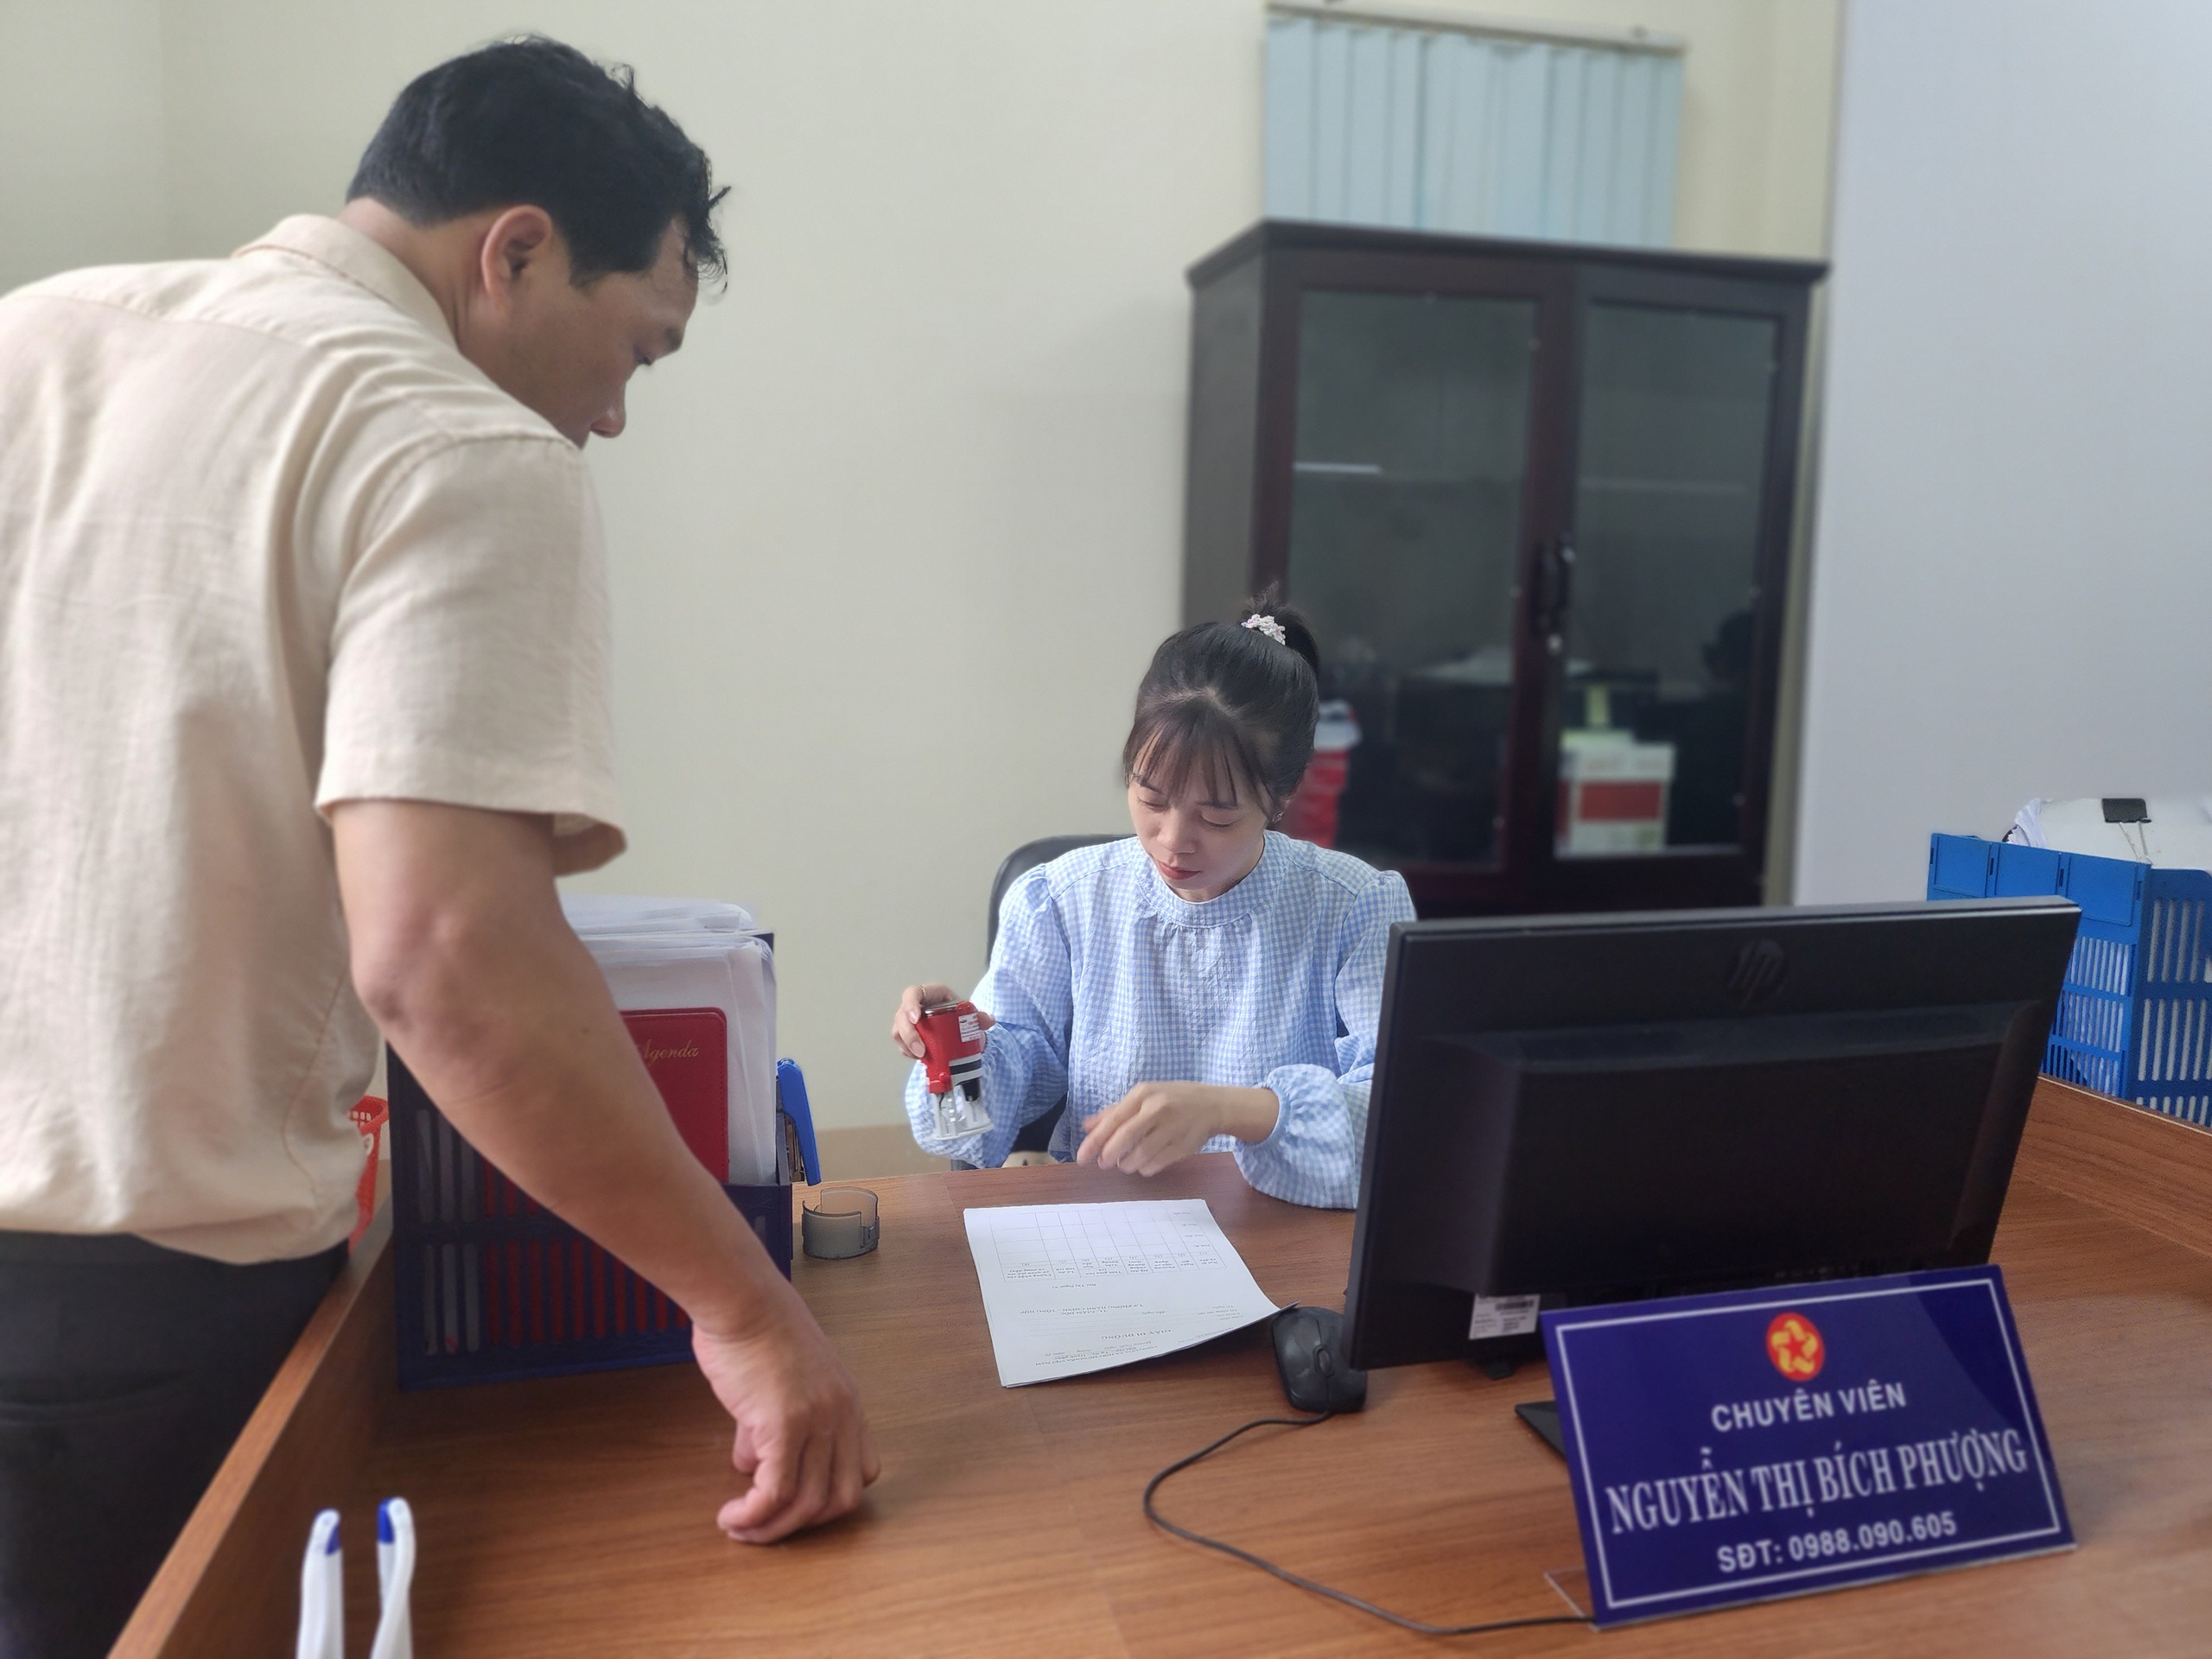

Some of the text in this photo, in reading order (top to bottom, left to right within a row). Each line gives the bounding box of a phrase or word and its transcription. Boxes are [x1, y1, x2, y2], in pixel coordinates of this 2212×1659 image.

[1711, 1378, 1908, 1433] CHUYÊN VIÊN
[1604, 1427, 2029, 1535] NGUYỄN THỊ BÍCH PHƯỢNG
[1716, 1510, 1958, 1573] SĐT: 0988.090.605
